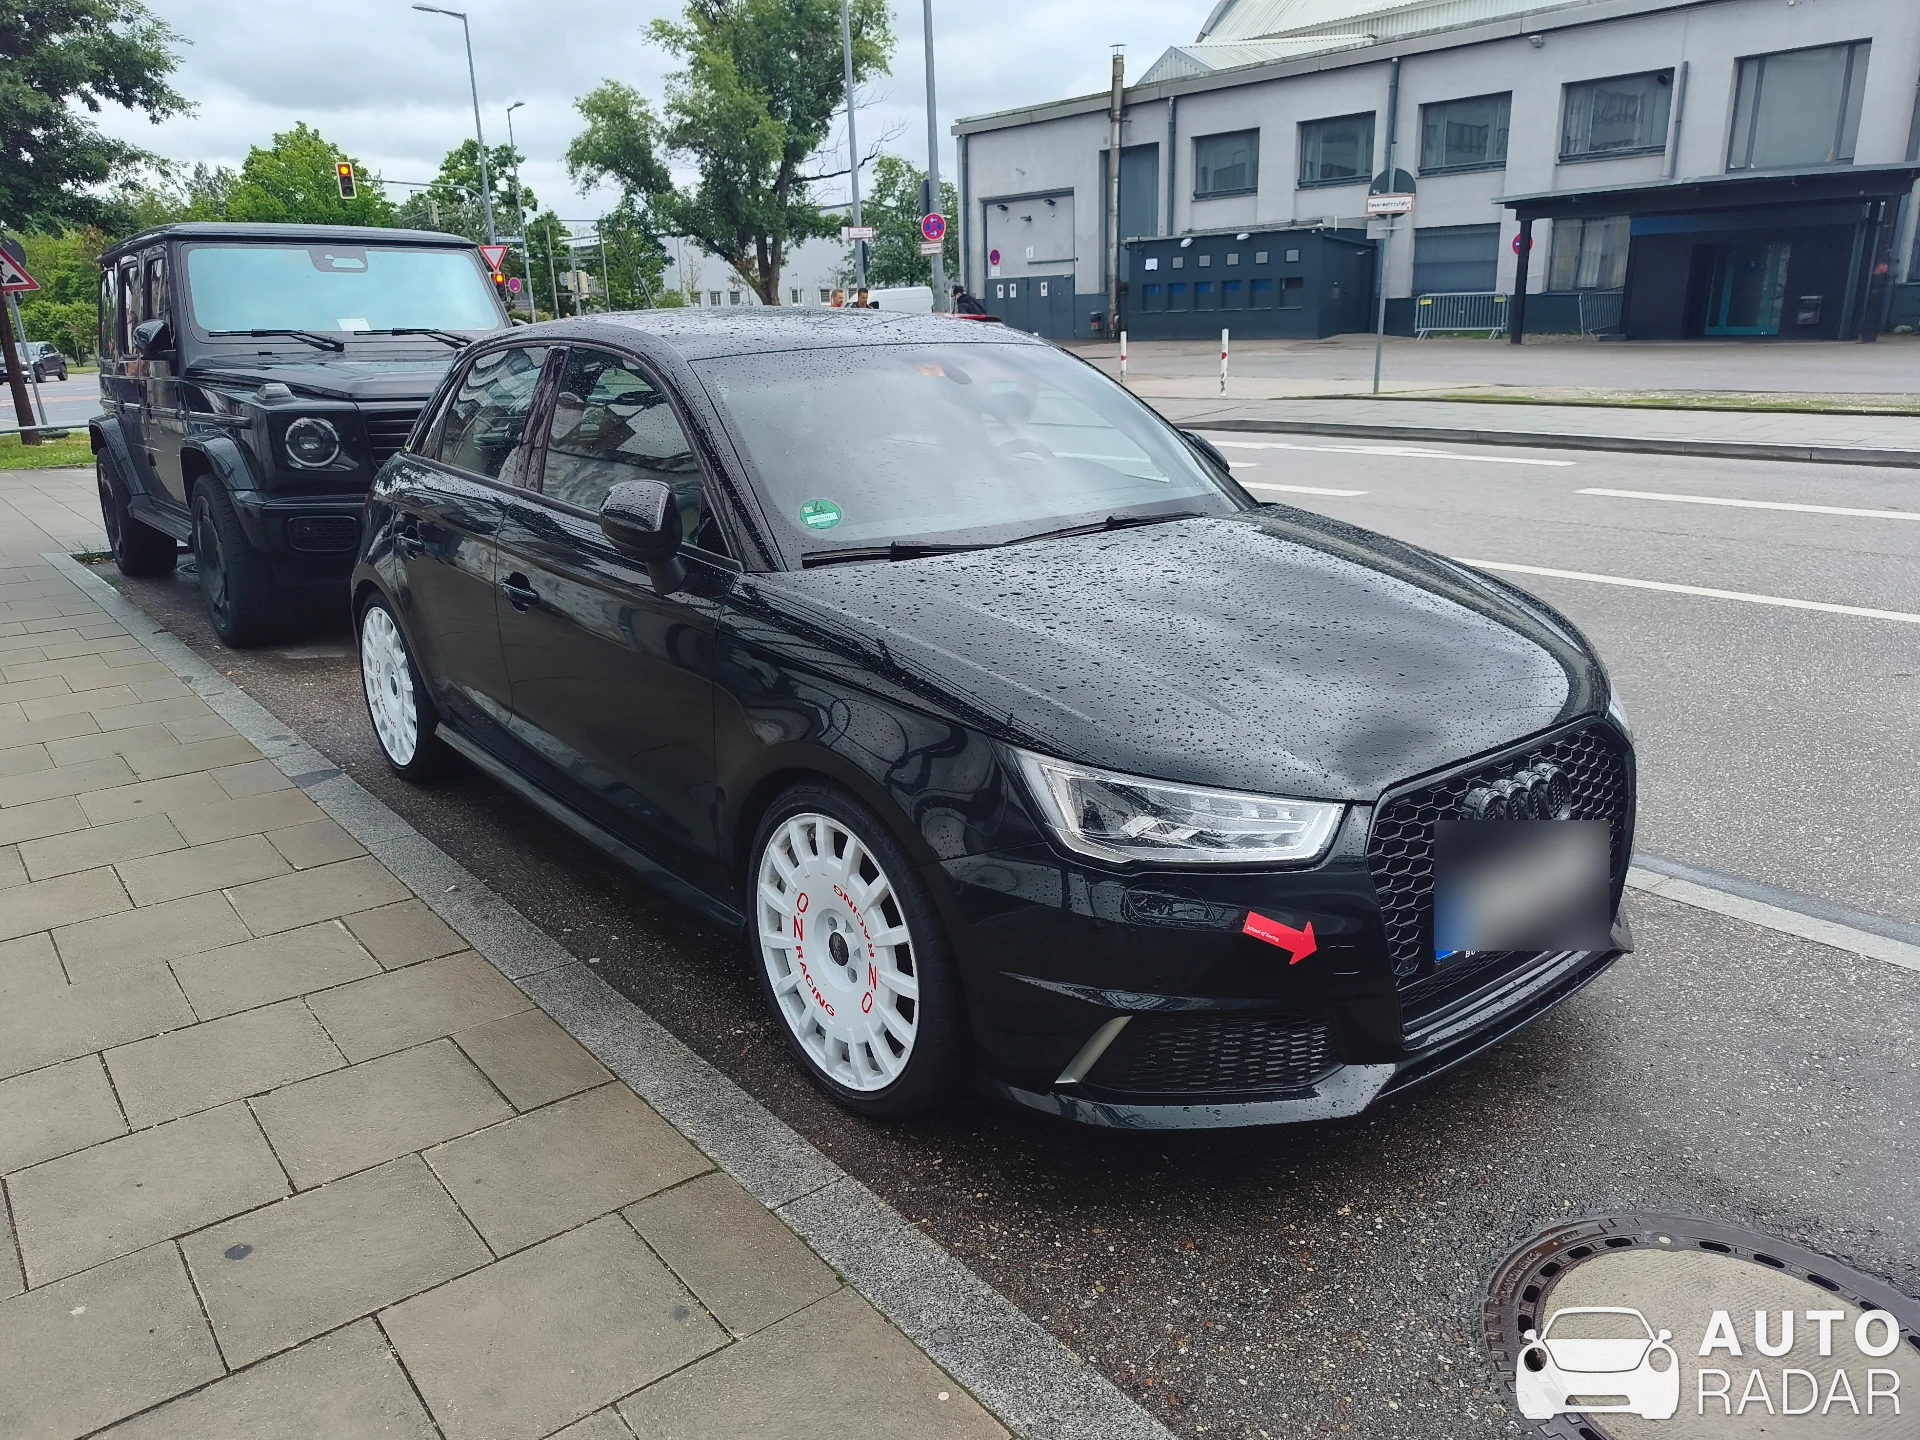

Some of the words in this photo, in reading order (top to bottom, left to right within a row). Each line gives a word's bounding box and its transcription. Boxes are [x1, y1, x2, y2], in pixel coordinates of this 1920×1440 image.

[833, 884, 875, 957] RACING
[1246, 925, 1261, 935] School
[1265, 932, 1280, 943] Racing
[796, 946, 835, 1017] RACING
